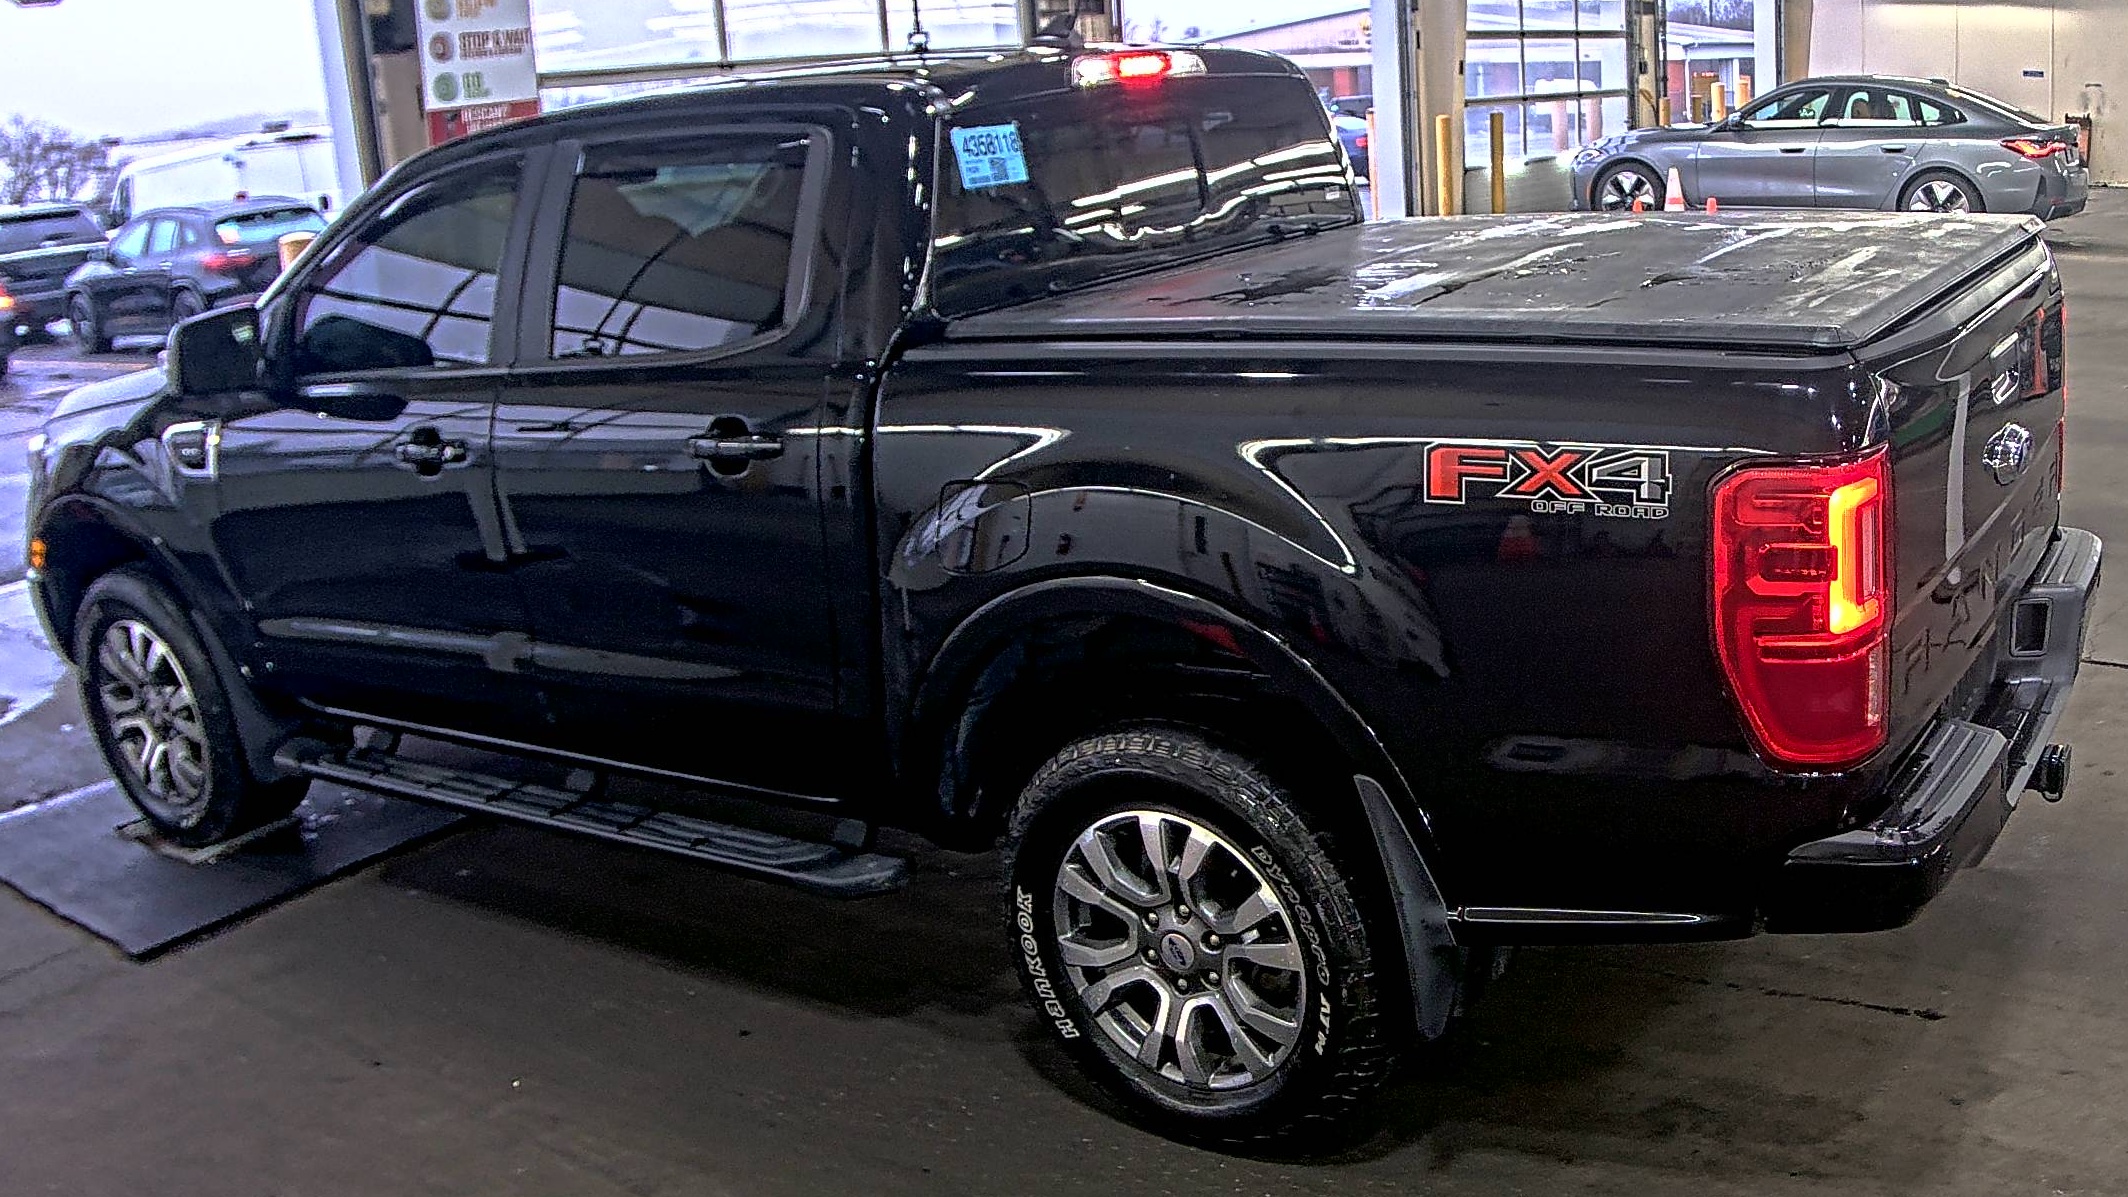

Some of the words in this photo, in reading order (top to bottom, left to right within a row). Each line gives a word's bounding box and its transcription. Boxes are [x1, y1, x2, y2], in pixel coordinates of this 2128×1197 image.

[1424, 441, 1672, 506] FX4
[1531, 500, 1585, 514] OFF
[1595, 503, 1669, 519] ROAD
[1017, 884, 1080, 1038] HANKOOK
[1251, 845, 1330, 985] DYNAPRO
